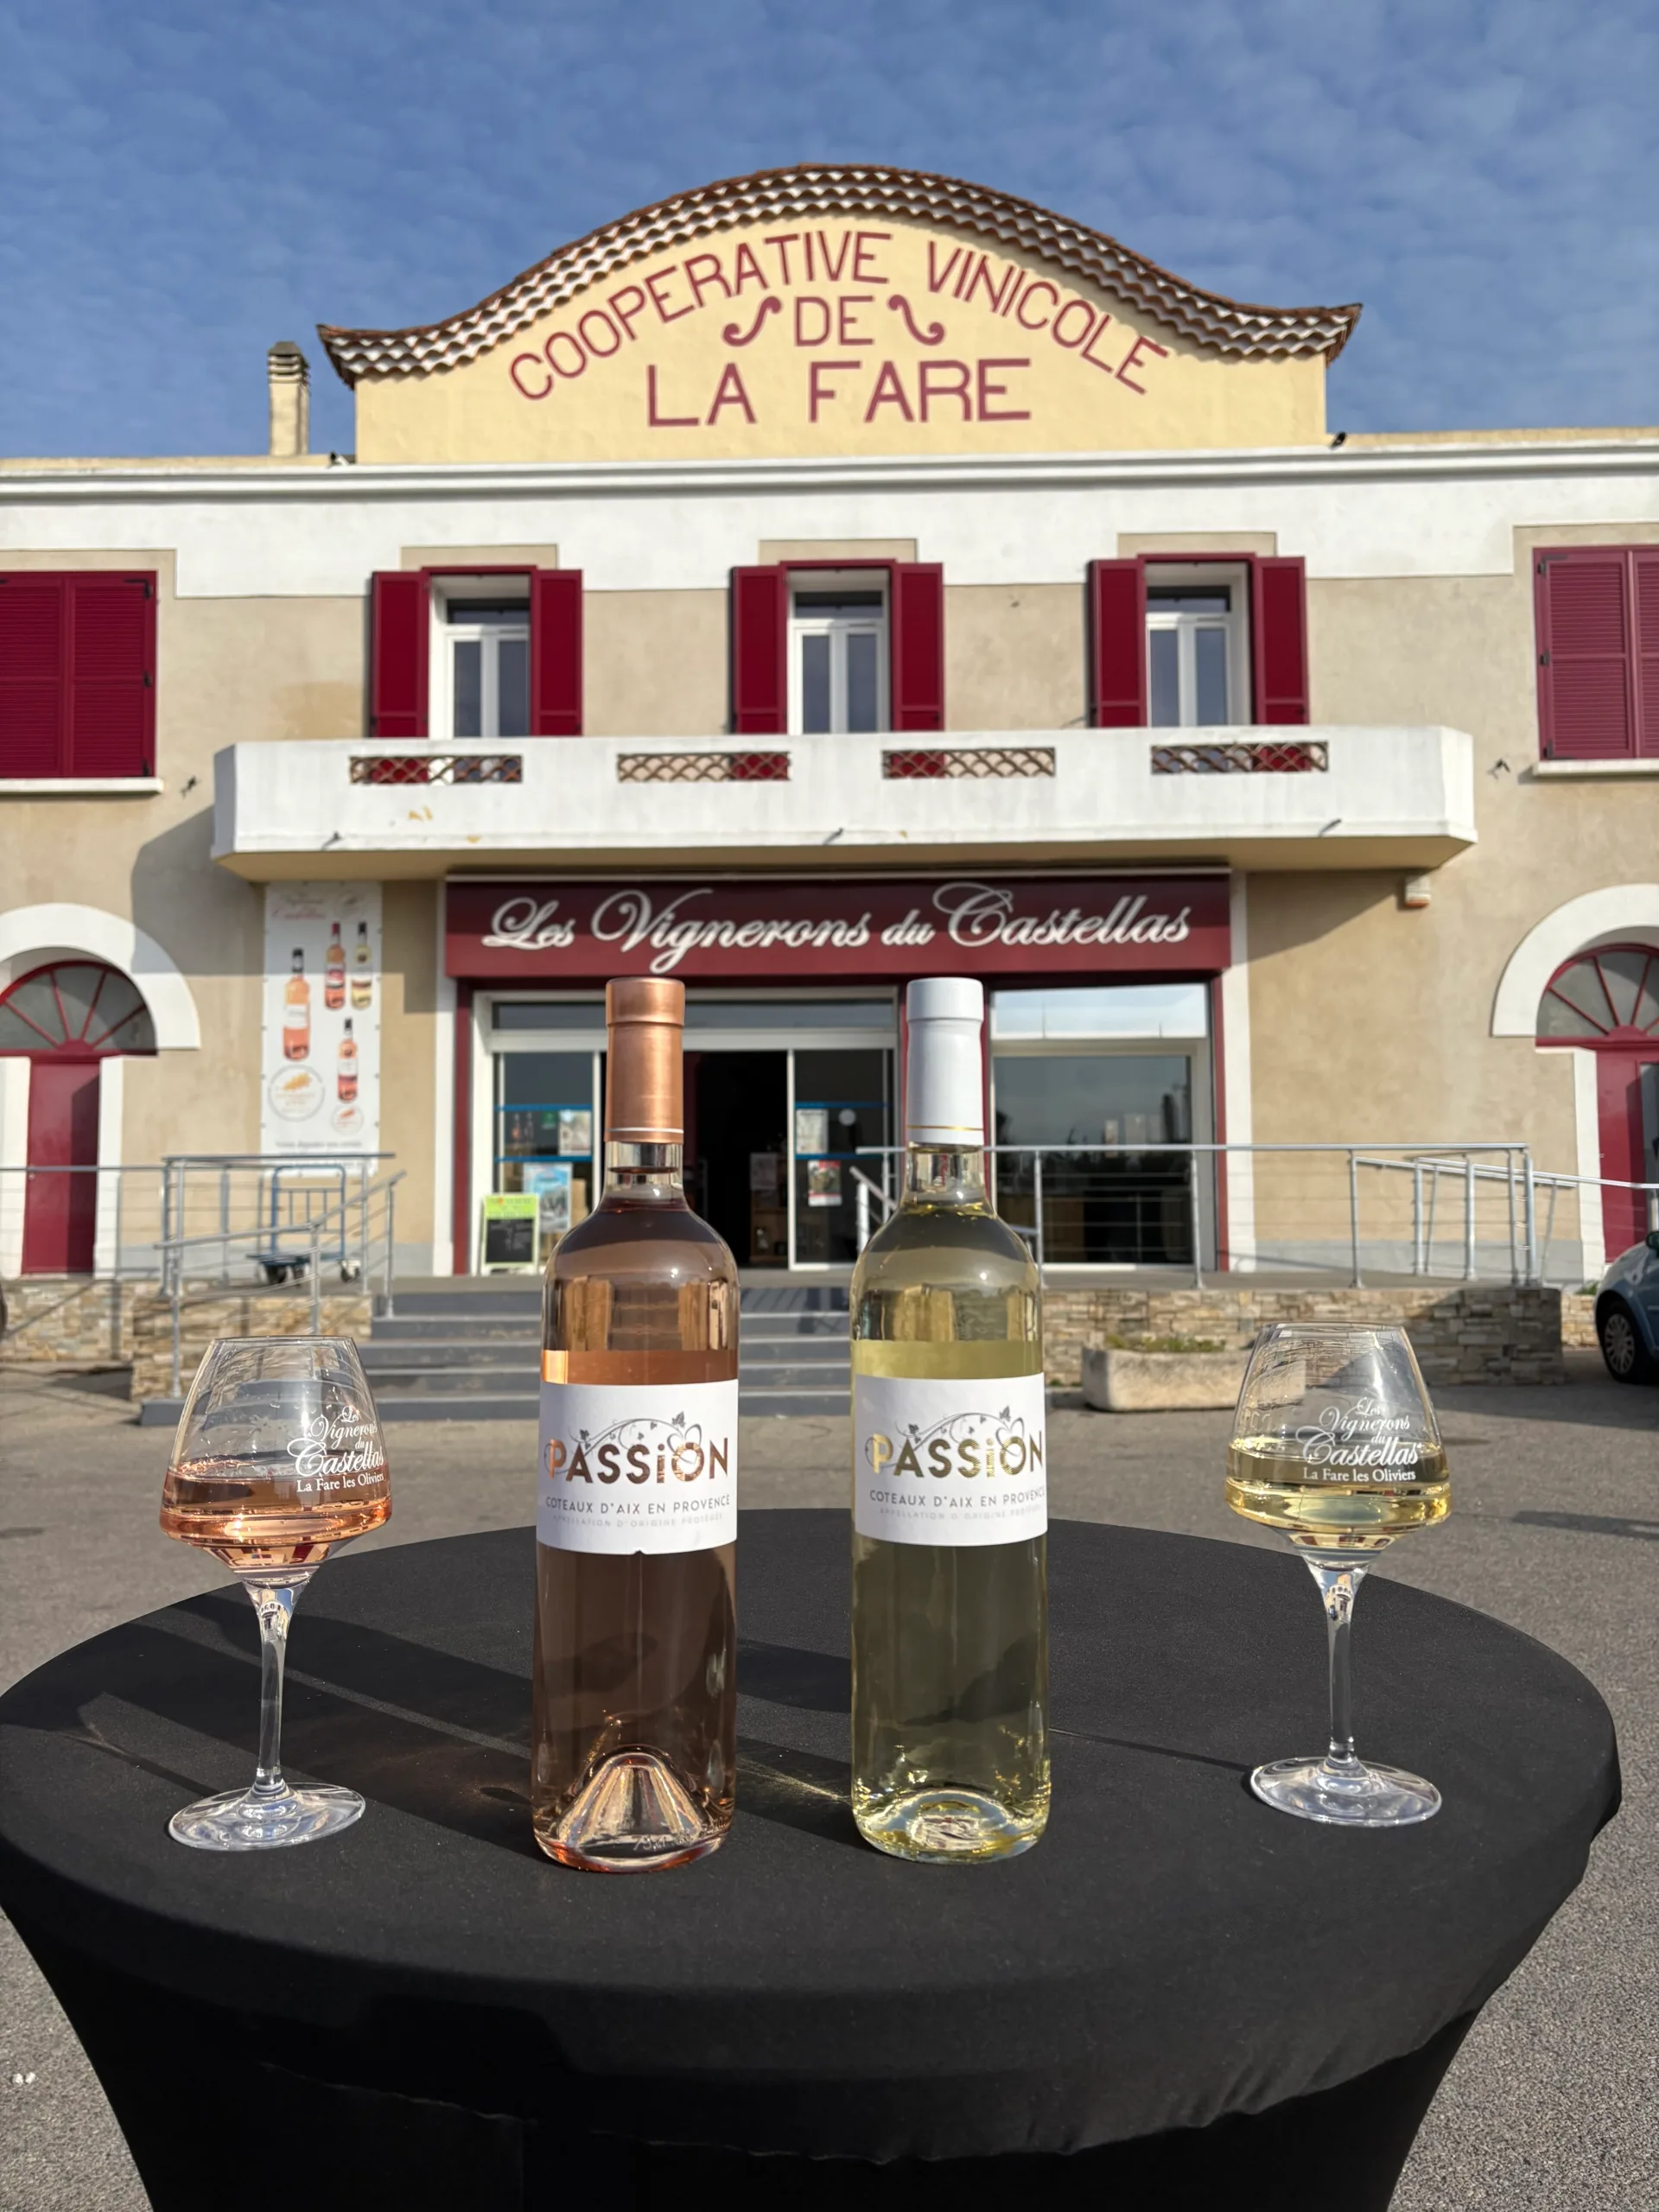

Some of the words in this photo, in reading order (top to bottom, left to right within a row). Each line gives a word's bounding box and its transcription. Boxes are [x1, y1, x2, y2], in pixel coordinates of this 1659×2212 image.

[510, 231, 892, 402] COOPERATIVE
[927, 239, 1169, 395] VINICOLE
[794, 295, 874, 346] DE
[647, 362, 758, 427] LA
[809, 359, 1032, 423] FARE
[480, 897, 576, 950] Les
[591, 889, 871, 975] Vignerons
[880, 910, 936, 946] du
[932, 881, 1192, 947] Castellas
[1319, 1403, 1410, 1441] Vignerons
[1370, 1431, 1386, 1445] du
[287, 1438, 384, 1478] Castellas
[354, 1437, 365, 1450] du
[1295, 1426, 1418, 1466] Castellas
[296, 1479, 312, 1492] La
[316, 1477, 340, 1491] Fare
[343, 1475, 355, 1488] les
[358, 1471, 384, 1486] Oliviers
[1303, 1467, 1319, 1480] La
[1323, 1469, 1350, 1482] Fare
[1353, 1469, 1370, 1482] les
[1372, 1469, 1416, 1483] Oliviers
[545, 1496, 594, 1513] COTEAUX
[600, 1503, 640, 1515] D'AIX
[648, 1503, 666, 1514] EN
[673, 1494, 731, 1513] PROVENCE
[869, 1490, 925, 1506] COTEAUX
[933, 1496, 973, 1508] D'AIX
[981, 1496, 997, 1507] EN
